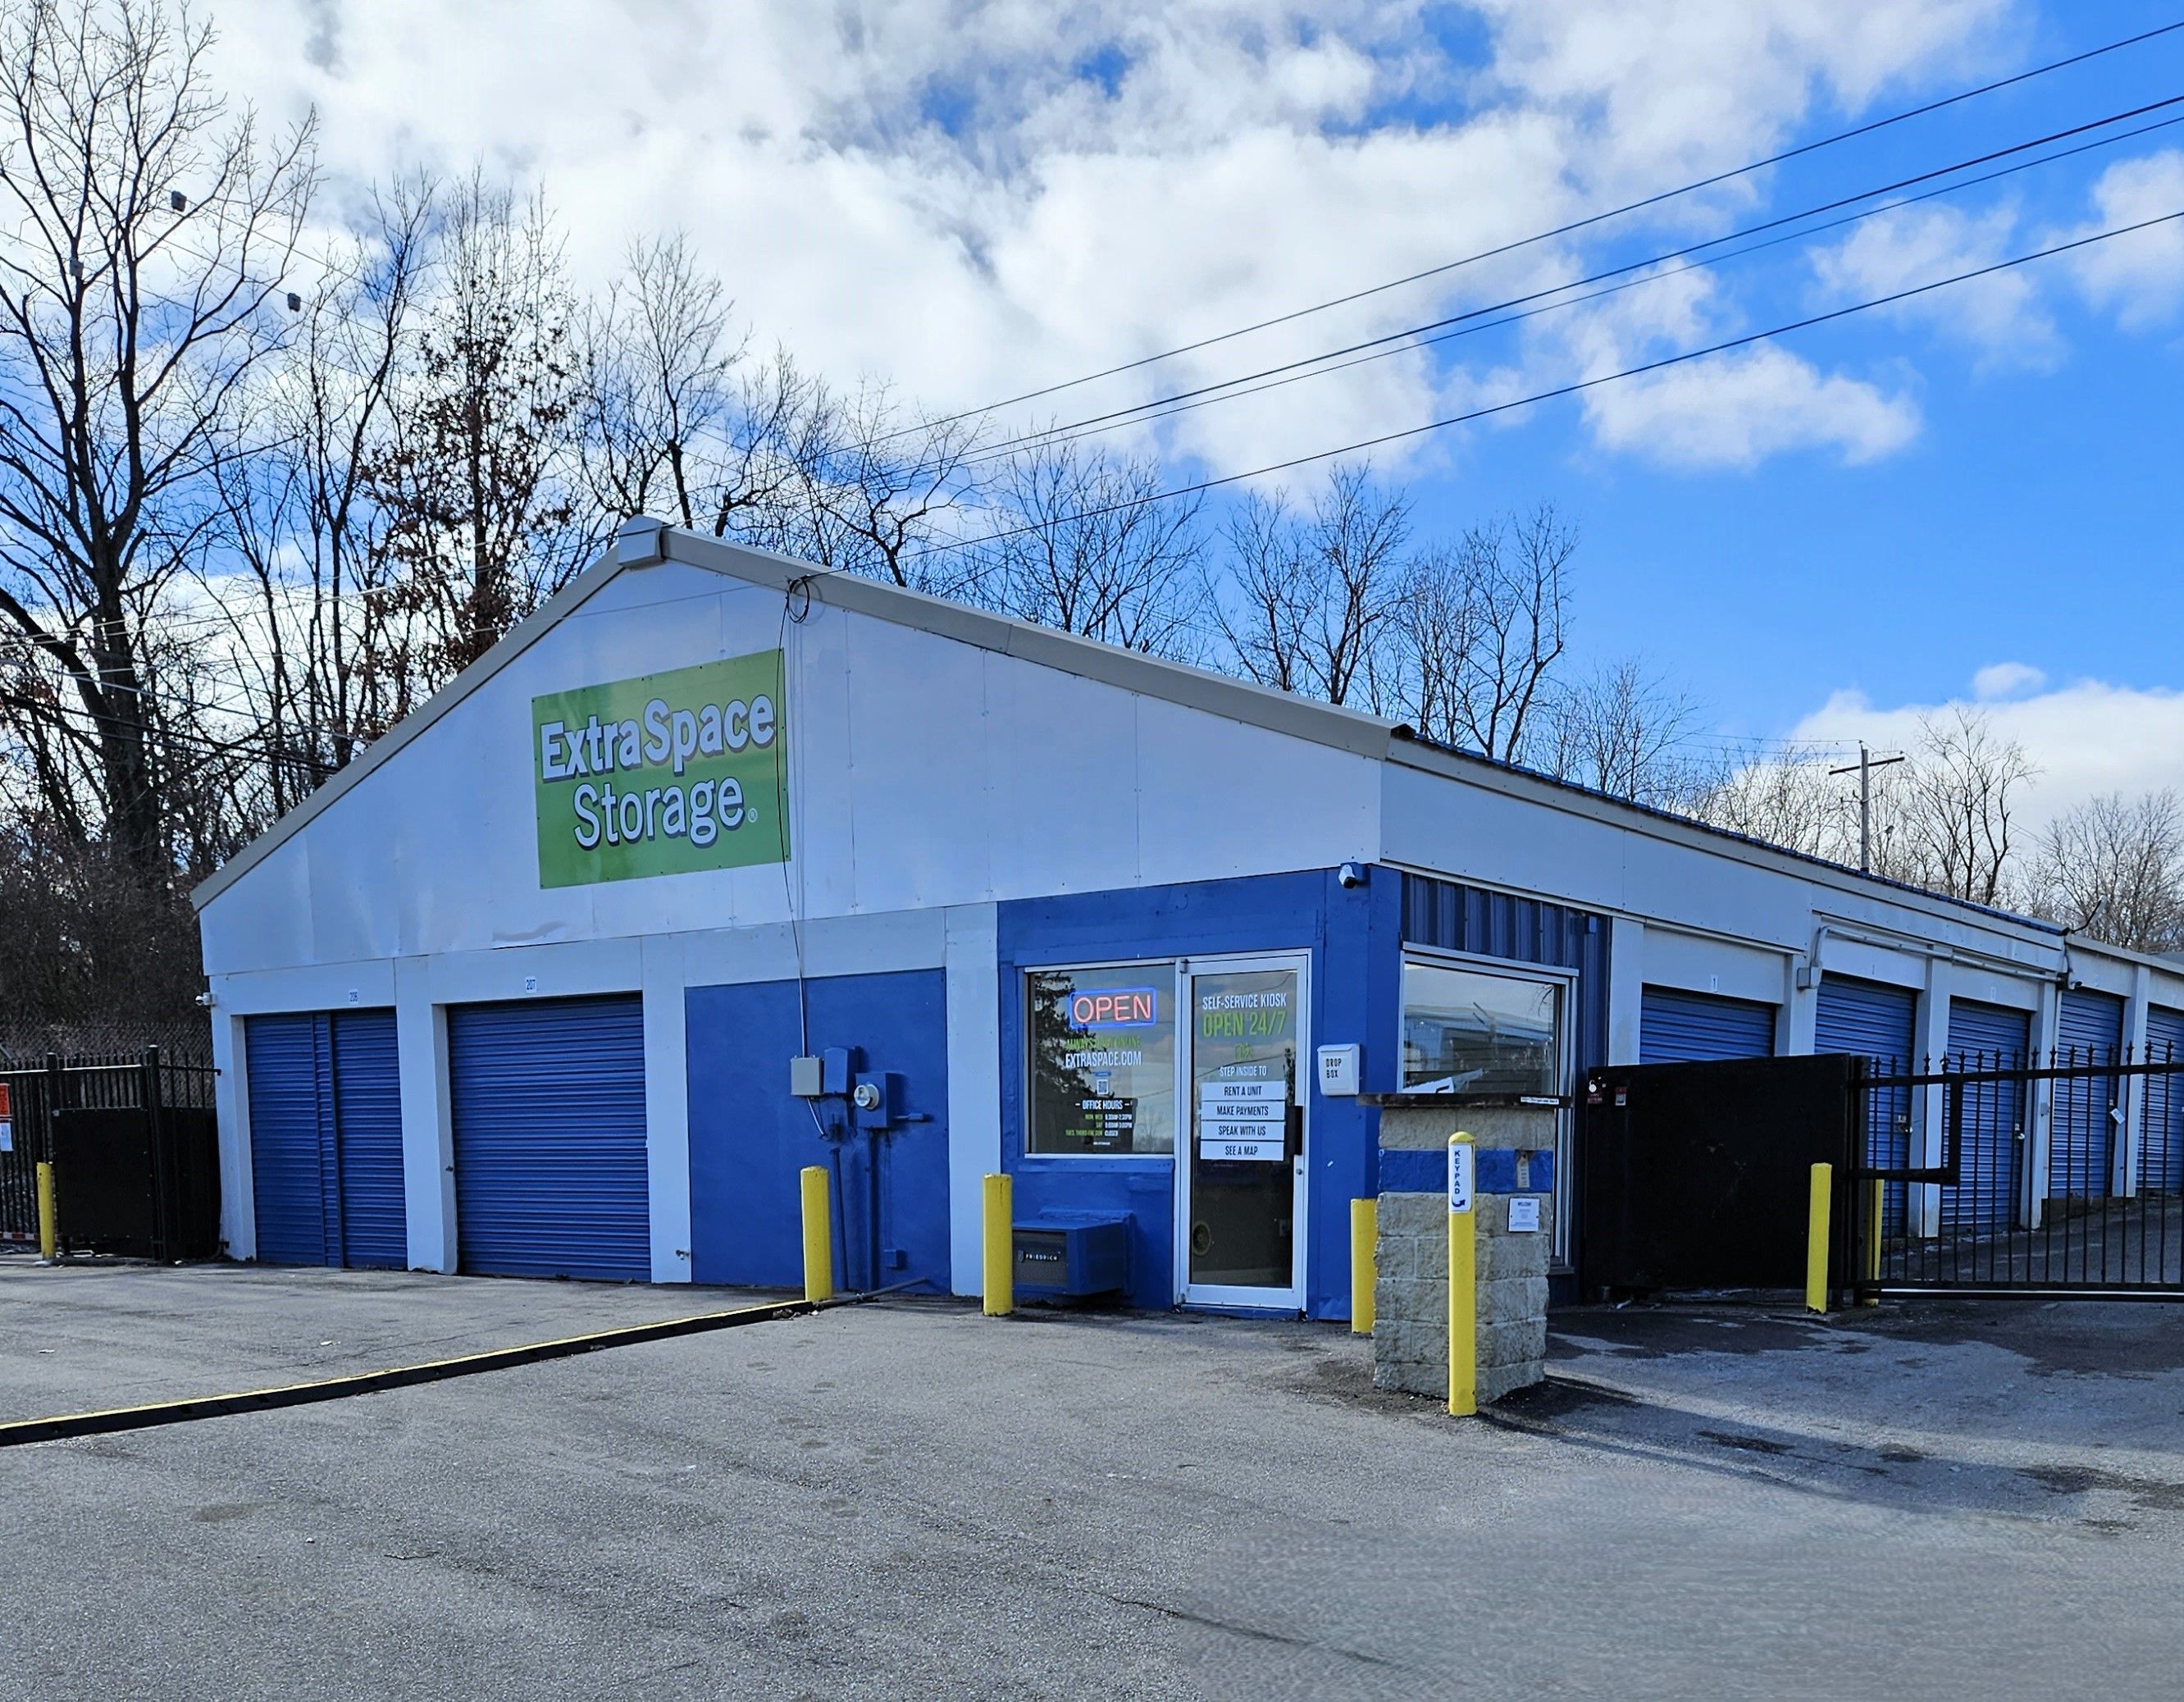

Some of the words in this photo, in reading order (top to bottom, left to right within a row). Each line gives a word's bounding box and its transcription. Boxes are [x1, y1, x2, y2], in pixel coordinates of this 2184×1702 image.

[573, 777, 745, 850] Storage
[1202, 994, 1258, 1010] SELF-SERVICE
[1261, 992, 1287, 1007] KIOSK
[1074, 994, 1151, 1023] OPEN
[1203, 1013, 1244, 1037] OPEN
[1249, 1010, 1287, 1036] 24/7
[1065, 1051, 1142, 1068] EXTRASPACE.COM
[1325, 1058, 1342, 1067] DROP
[1220, 1066, 1236, 1077] STEP
[1236, 1066, 1257, 1076] INSIDE
[1259, 1065, 1267, 1076] TO
[1326, 1070, 1338, 1079] BOX
[1224, 1086, 1240, 1096] RENT
[1241, 1086, 1246, 1096] A
[1247, 1085, 1262, 1096] UNIT
[1083, 1100, 1101, 1110] OFFICE
[1102, 1100, 1123, 1110] HOURS
[1216, 1106, 1234, 1116] MAKE
[1236, 1106, 1269, 1116] PAYMENTS
[1218, 1125, 1238, 1135] SPEAK
[1240, 1125, 1256, 1135] WITH
[1257, 1125, 1266, 1136] US
[1225, 1145, 1236, 1156] SEE
[1238, 1146, 1242, 1155] A
[1243, 1146, 1258, 1156] MAP
[1453, 1150, 1461, 1194] KEYPAD
